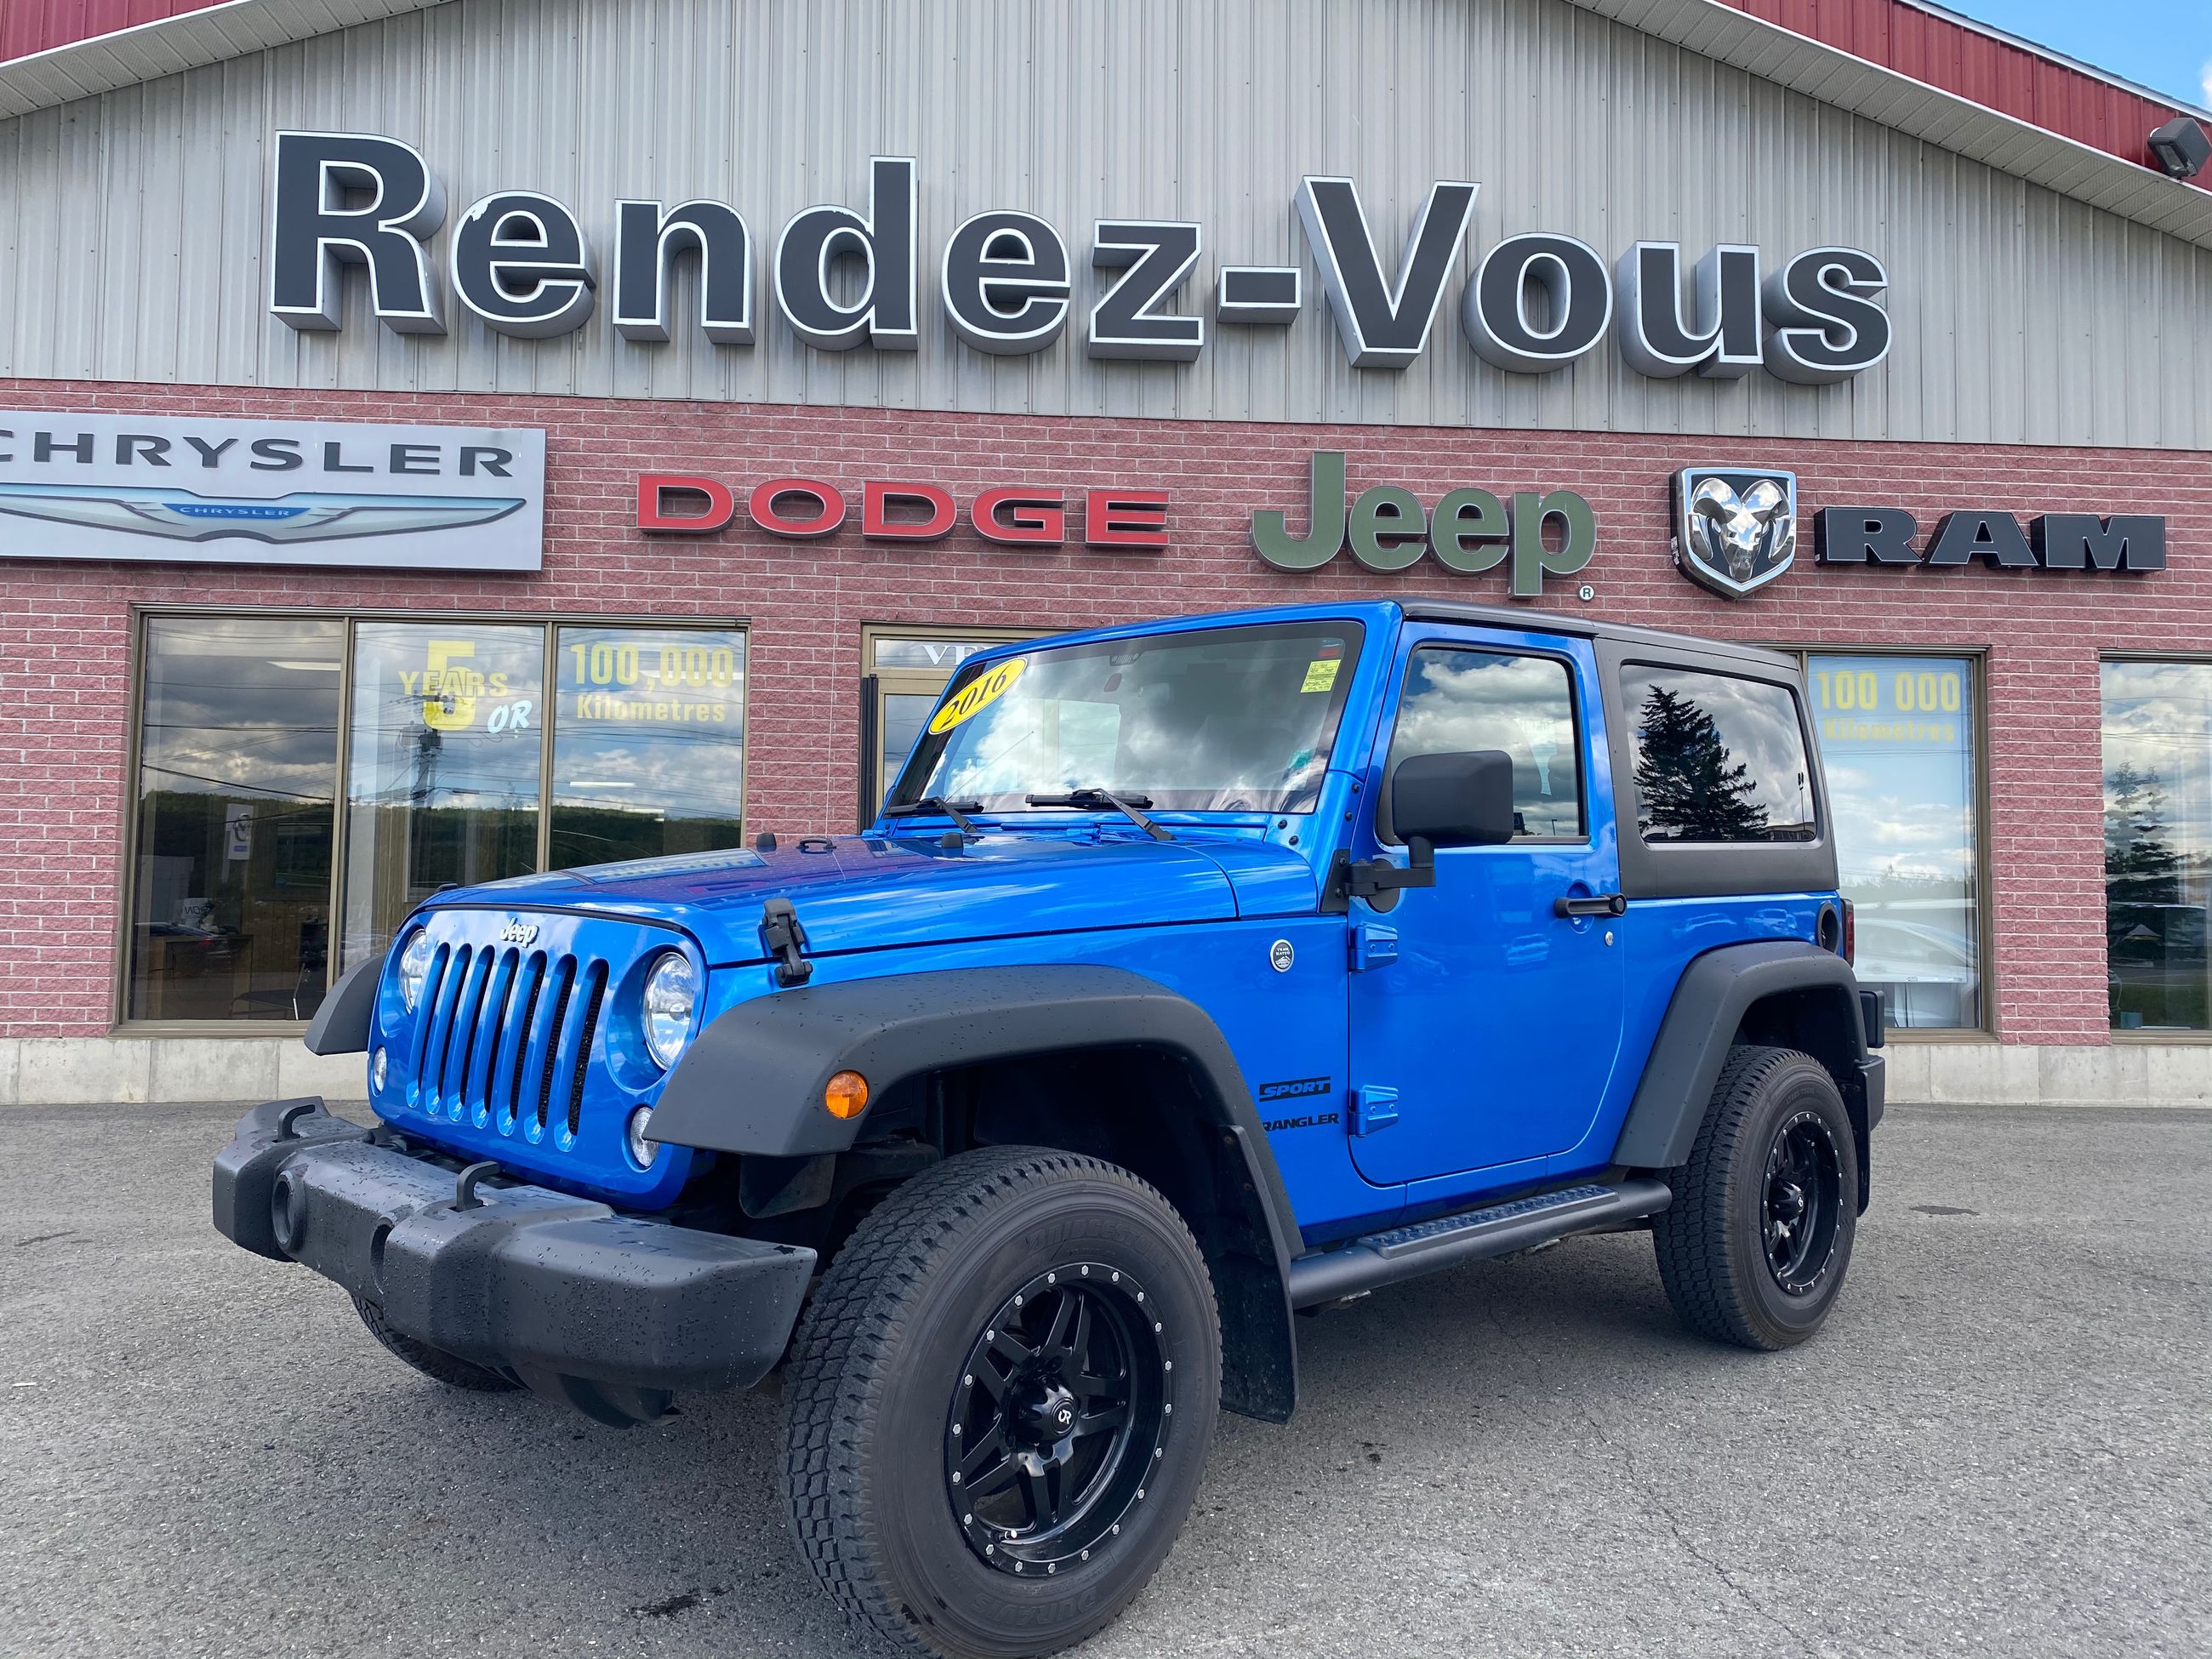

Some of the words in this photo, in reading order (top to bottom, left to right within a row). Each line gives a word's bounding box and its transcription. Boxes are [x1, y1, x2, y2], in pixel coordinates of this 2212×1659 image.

[269, 129, 1892, 378] Rendez-Vous
[0, 429, 514, 478] HRYSLER
[179, 506, 290, 516] CHRYSLER
[636, 473, 1171, 548] DODGE
[1251, 451, 1598, 598] Jeep
[1816, 506, 2166, 572] RAM
[398, 670, 509, 698] YEARS
[423, 640, 476, 731] 5
[571, 643, 733, 693] 100,000
[487, 699, 533, 734] OR
[576, 694, 727, 722] Kilometres
[938, 664, 1012, 730] 2016
[1824, 716, 1955, 743] Kilometres
[499, 916, 539, 949] Jeep
[1259, 1079, 1331, 1100] SPORT
[1262, 1112, 1340, 1132] RANGLER
